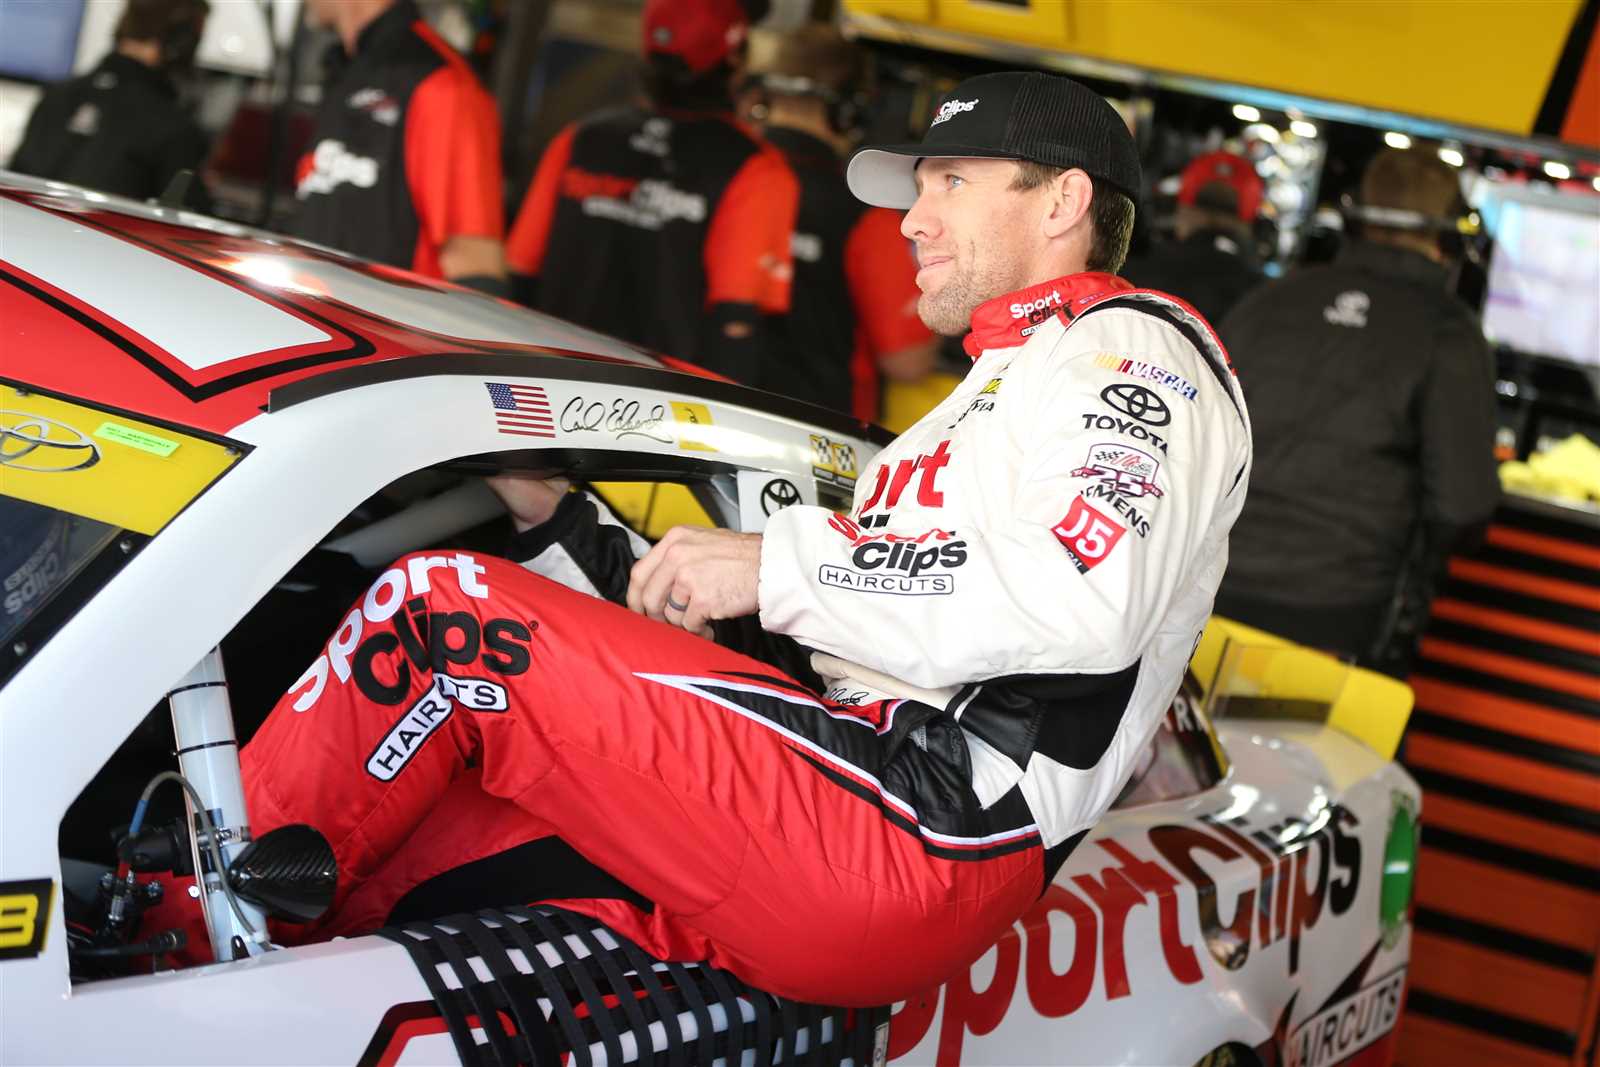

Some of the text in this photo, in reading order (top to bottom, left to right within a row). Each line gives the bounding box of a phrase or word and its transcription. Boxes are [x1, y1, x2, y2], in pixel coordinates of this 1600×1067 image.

[940, 99, 979, 115] Clips
[1010, 290, 1062, 319] Sport
[1130, 360, 1198, 401] NASCAR
[1082, 413, 1169, 457] TOYOTA
[852, 540, 968, 577] Clips
[826, 570, 947, 592] HAIRCUTS
[351, 597, 532, 706] Clips
[1148, 805, 1361, 976] Clips
